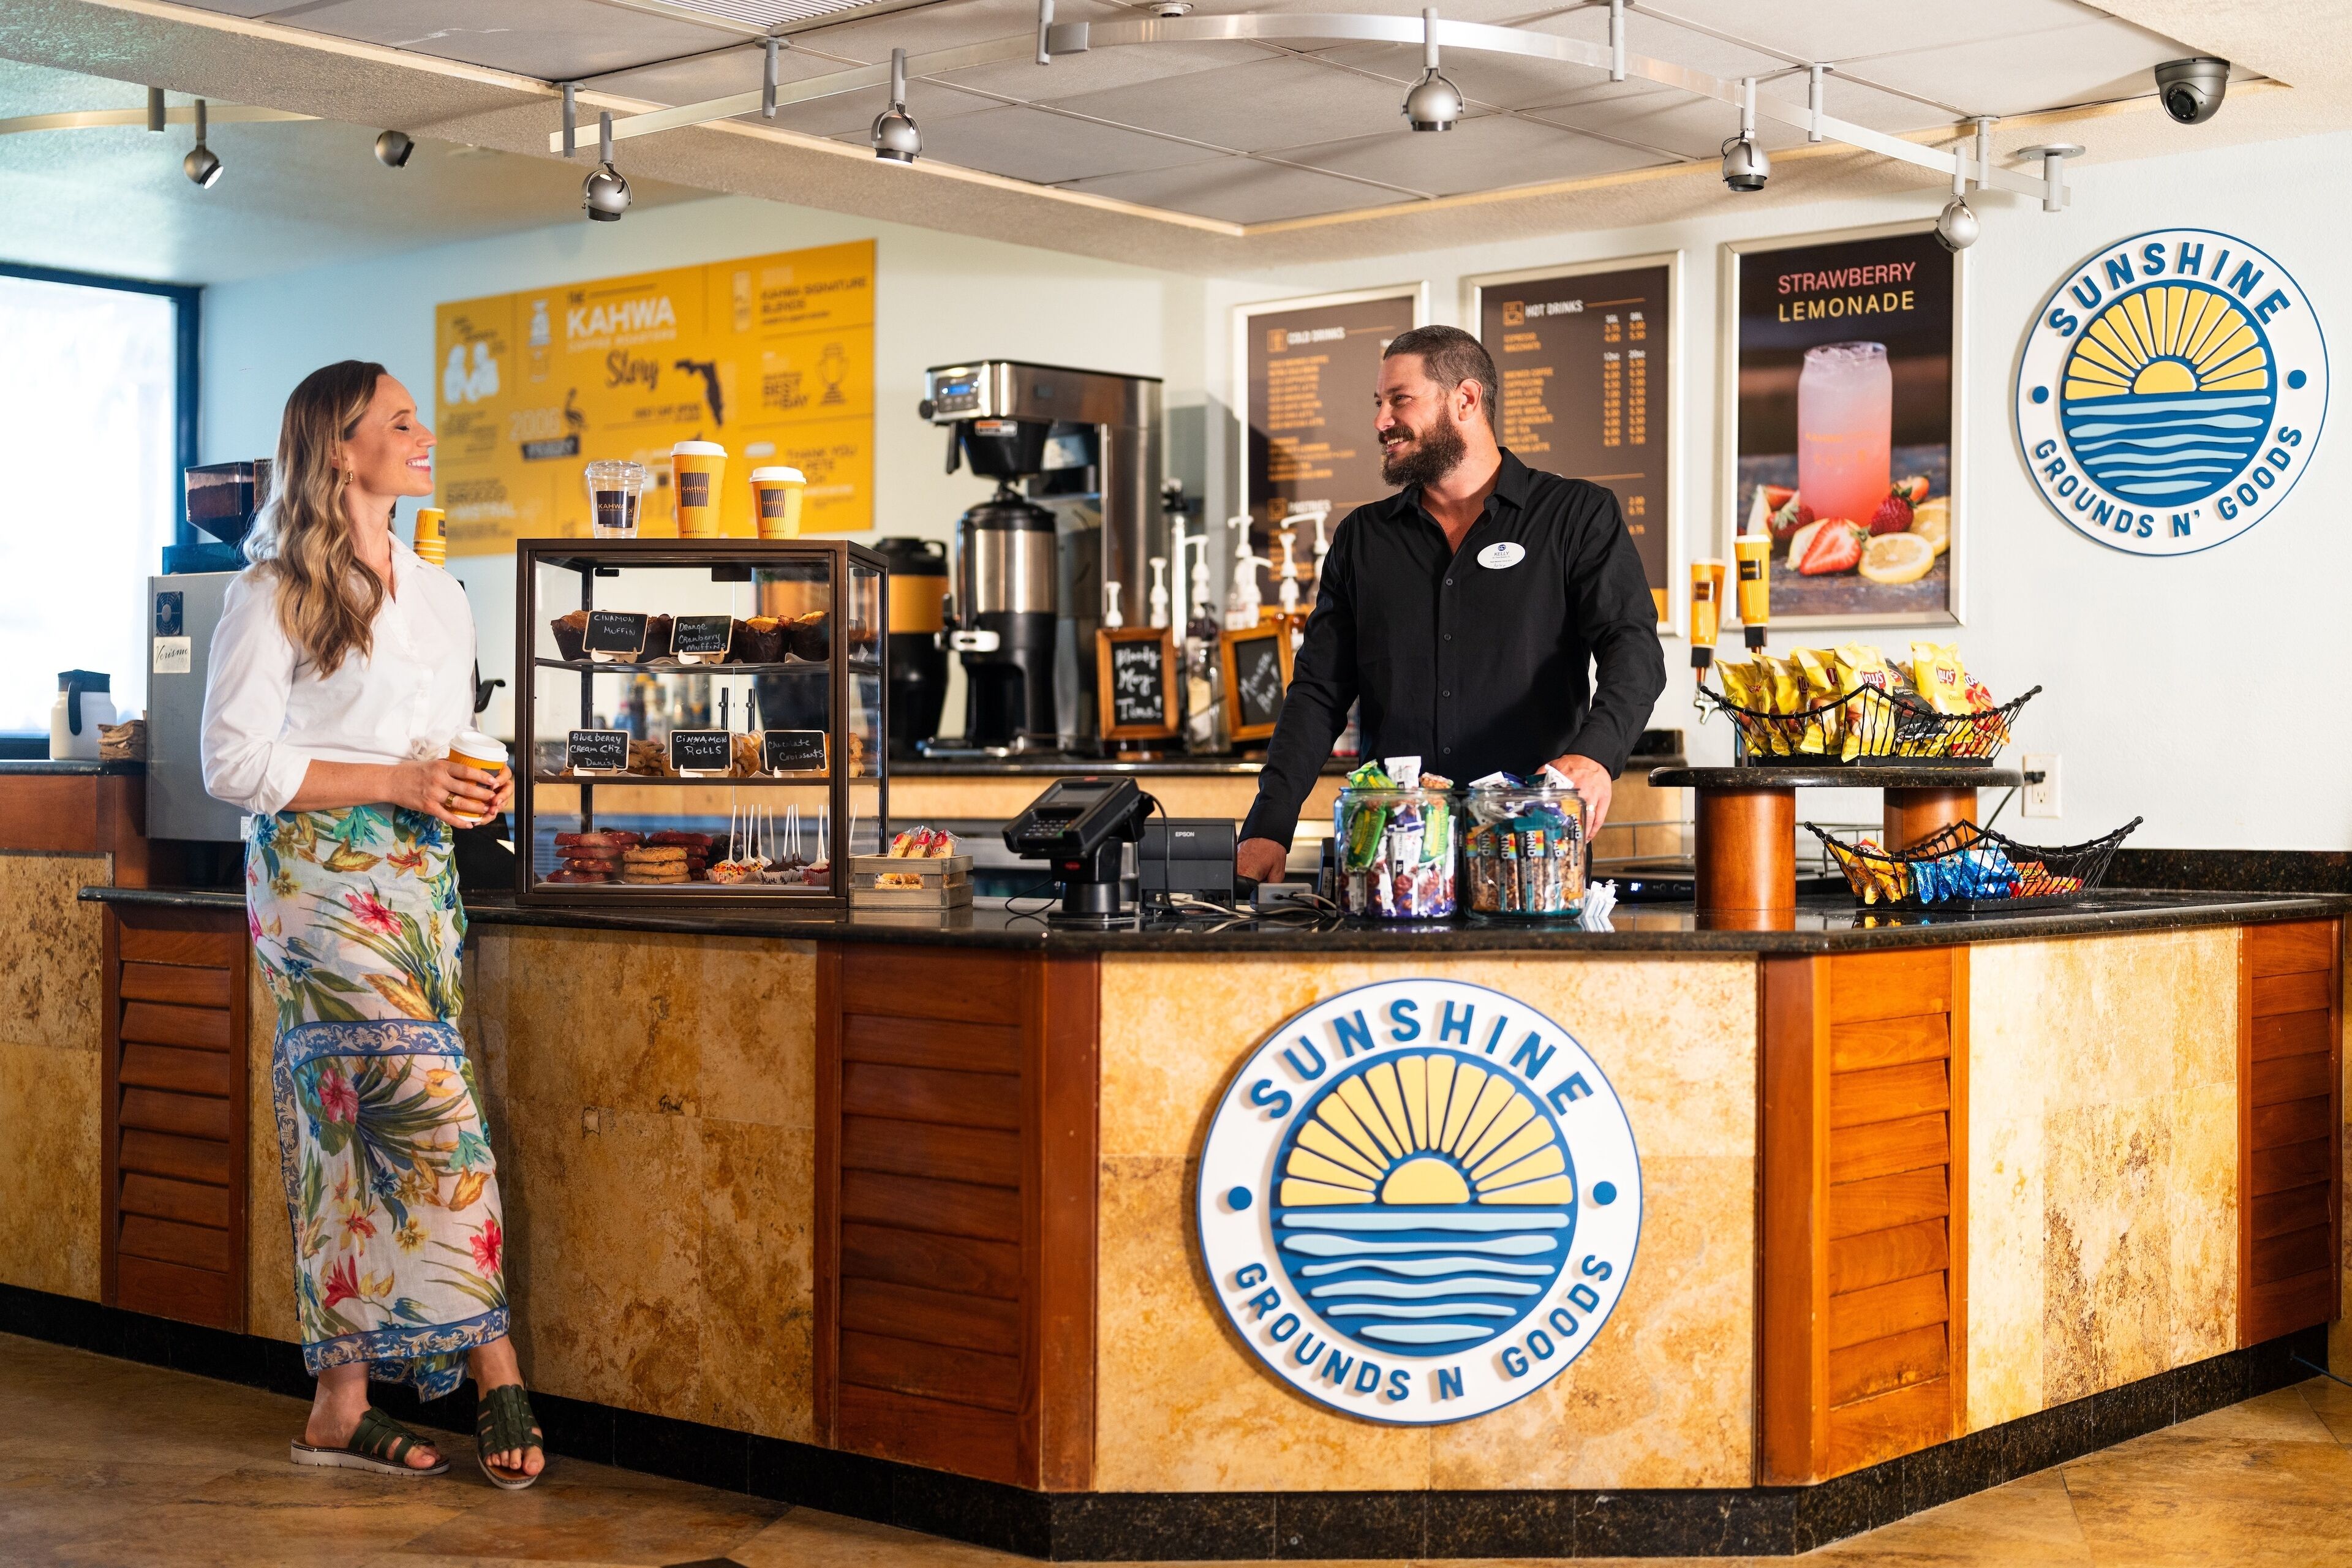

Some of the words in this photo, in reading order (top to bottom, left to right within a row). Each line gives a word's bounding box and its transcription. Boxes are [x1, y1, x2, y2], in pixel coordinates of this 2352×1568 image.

[1778, 262, 1917, 294] STRAWBERRY
[2048, 241, 2291, 337] SUNSHINE
[567, 295, 676, 338] KAHWA
[1525, 303, 1545, 317] HOT
[1547, 299, 1584, 315] DRINKS
[1779, 290, 1915, 322] LEMONADE
[2035, 439, 2154, 538] GROUNDS
[2172, 510, 2200, 537] N'
[2217, 426, 2302, 521] GOODS
[594, 614, 635, 623] CINAMON
[156, 644, 189, 664] Verismo
[779, 748, 824, 761] Croissants
[1481, 832, 1491, 856] KIND
[1500, 834, 1510, 859] KIND
[1526, 830, 1537, 856] KIND
[1251, 998, 1594, 1119] SUNSHINE
[1235, 1262, 1411, 1401] GROUNDS
[1501, 1254, 1613, 1379] GOODS
